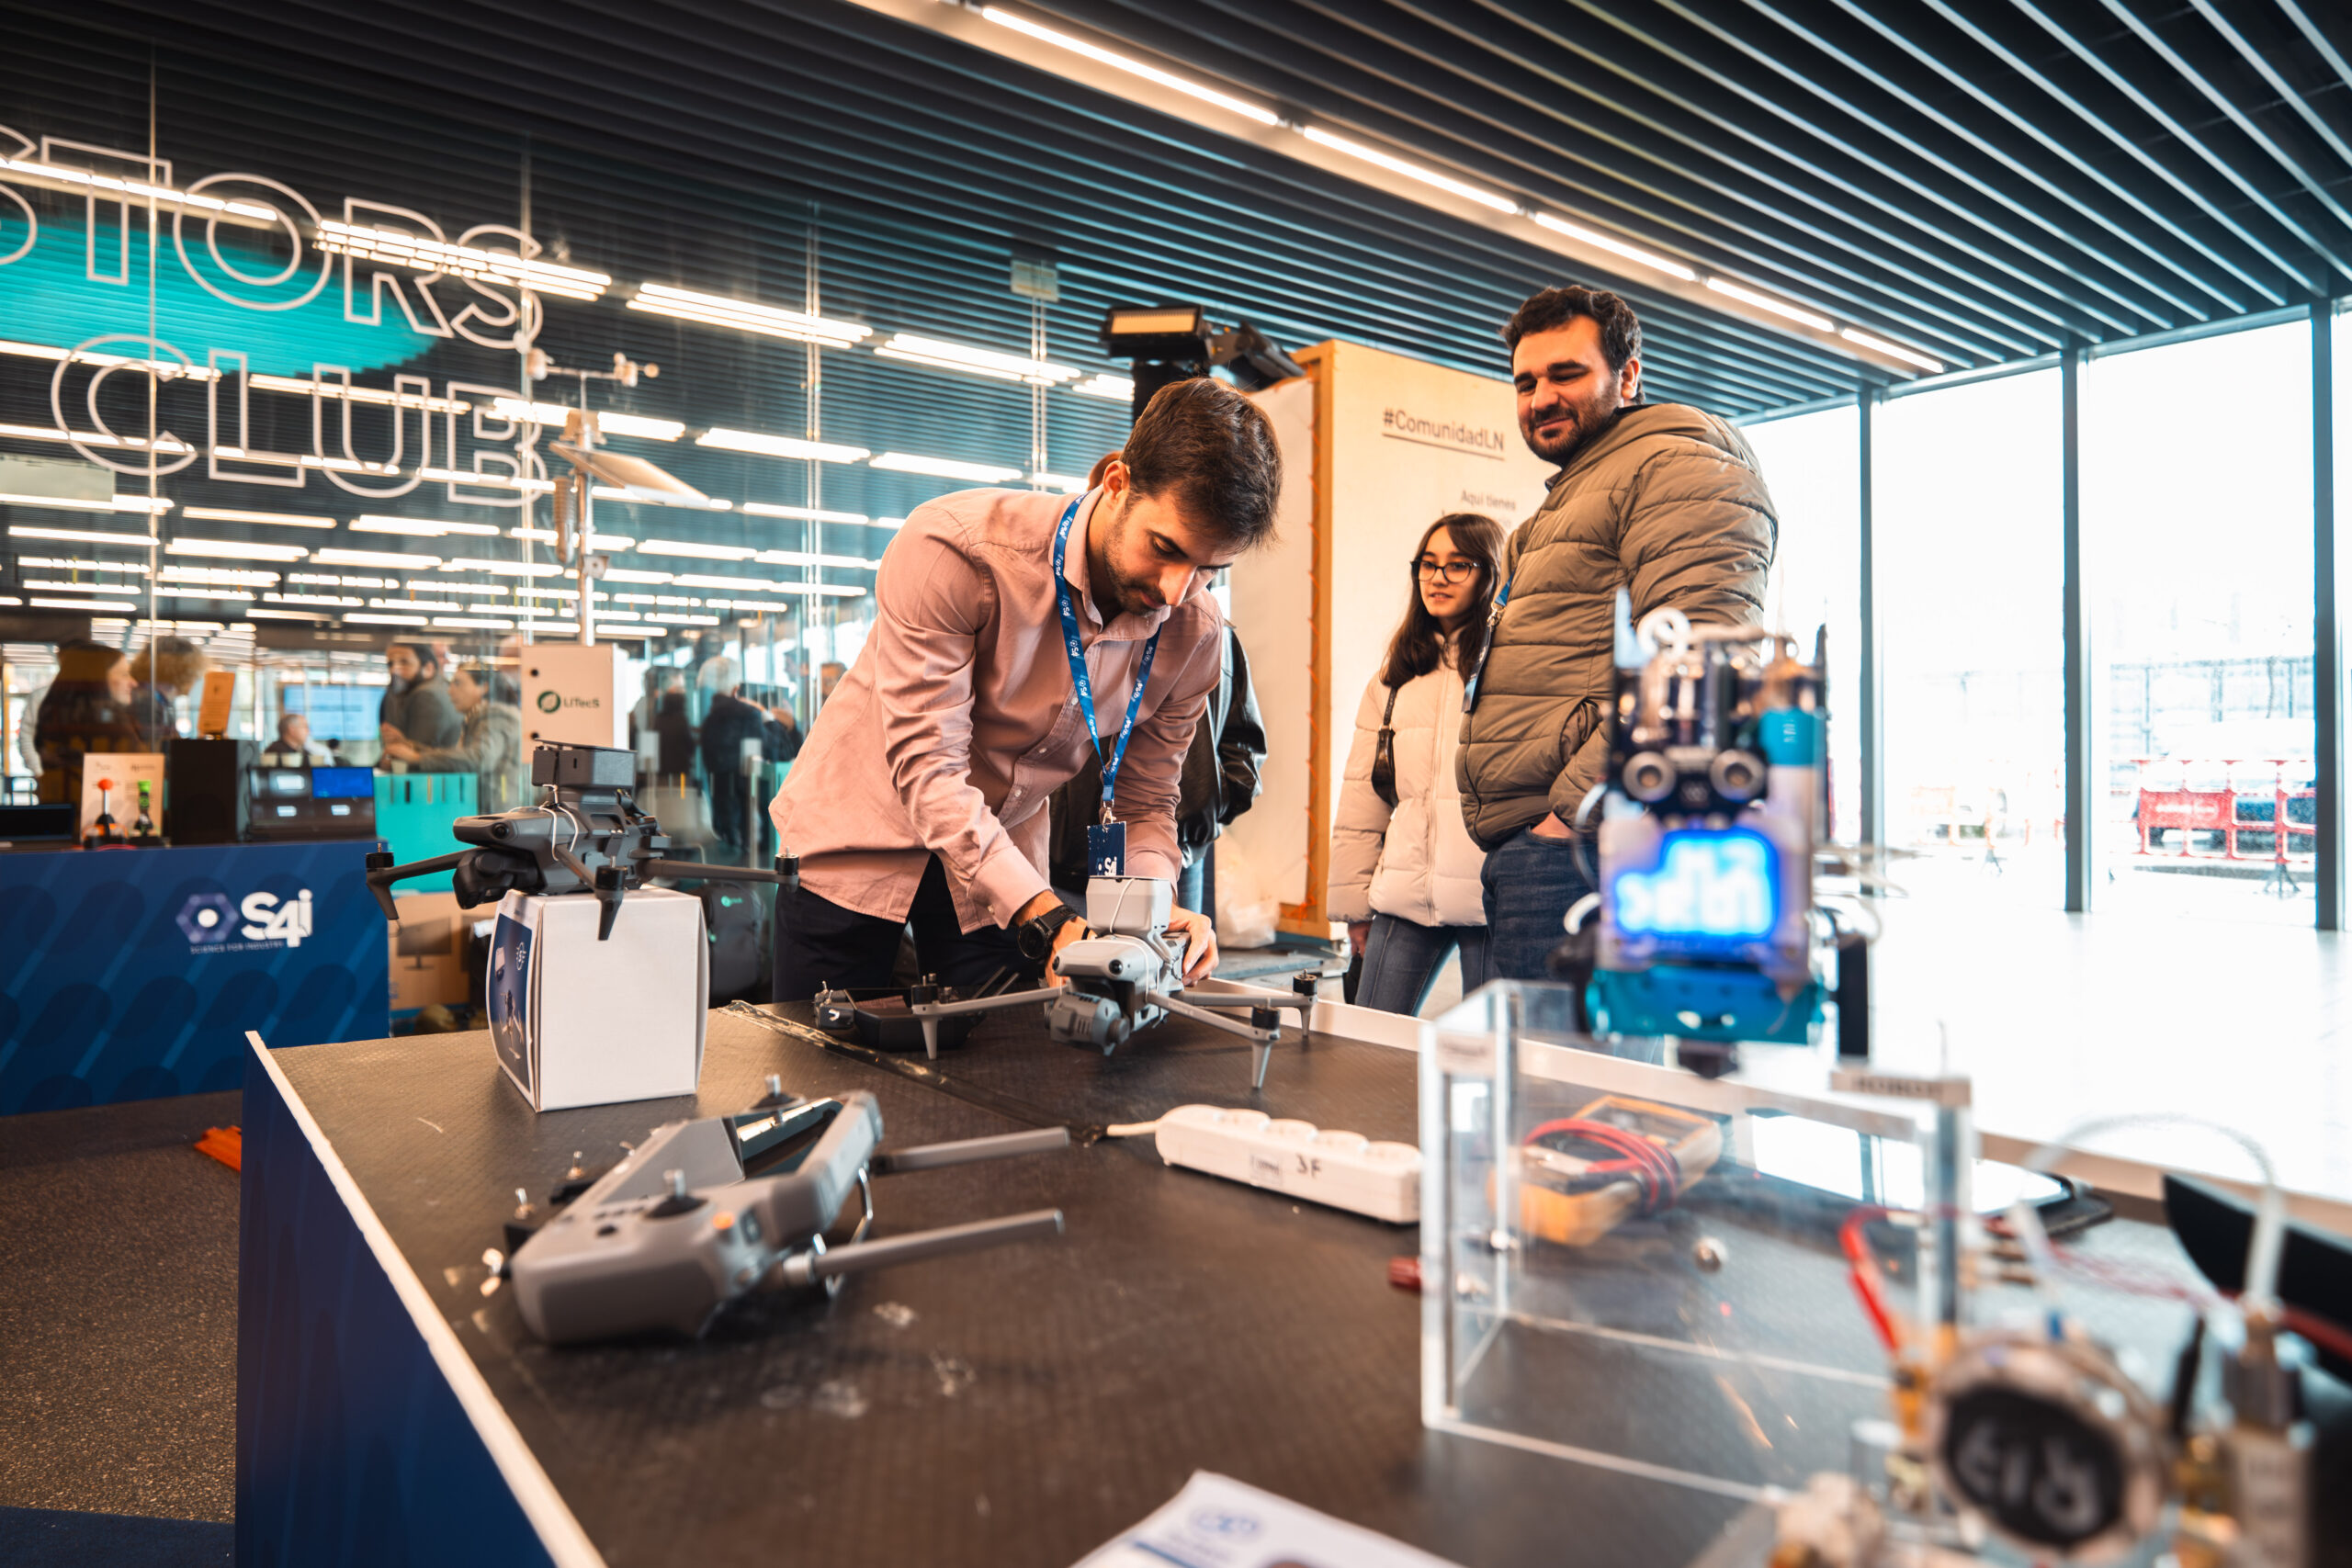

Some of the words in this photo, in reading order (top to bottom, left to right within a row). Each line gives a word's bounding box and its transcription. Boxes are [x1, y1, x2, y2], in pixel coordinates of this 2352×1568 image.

[51, 333, 548, 508] CLUB
[1383, 407, 1505, 452] #ComunidadLN
[241, 888, 313, 948] S4i
[189, 943, 225, 955] SCIENCE
[226, 942, 243, 953] FOR
[244, 940, 285, 951] INDUSTRY
